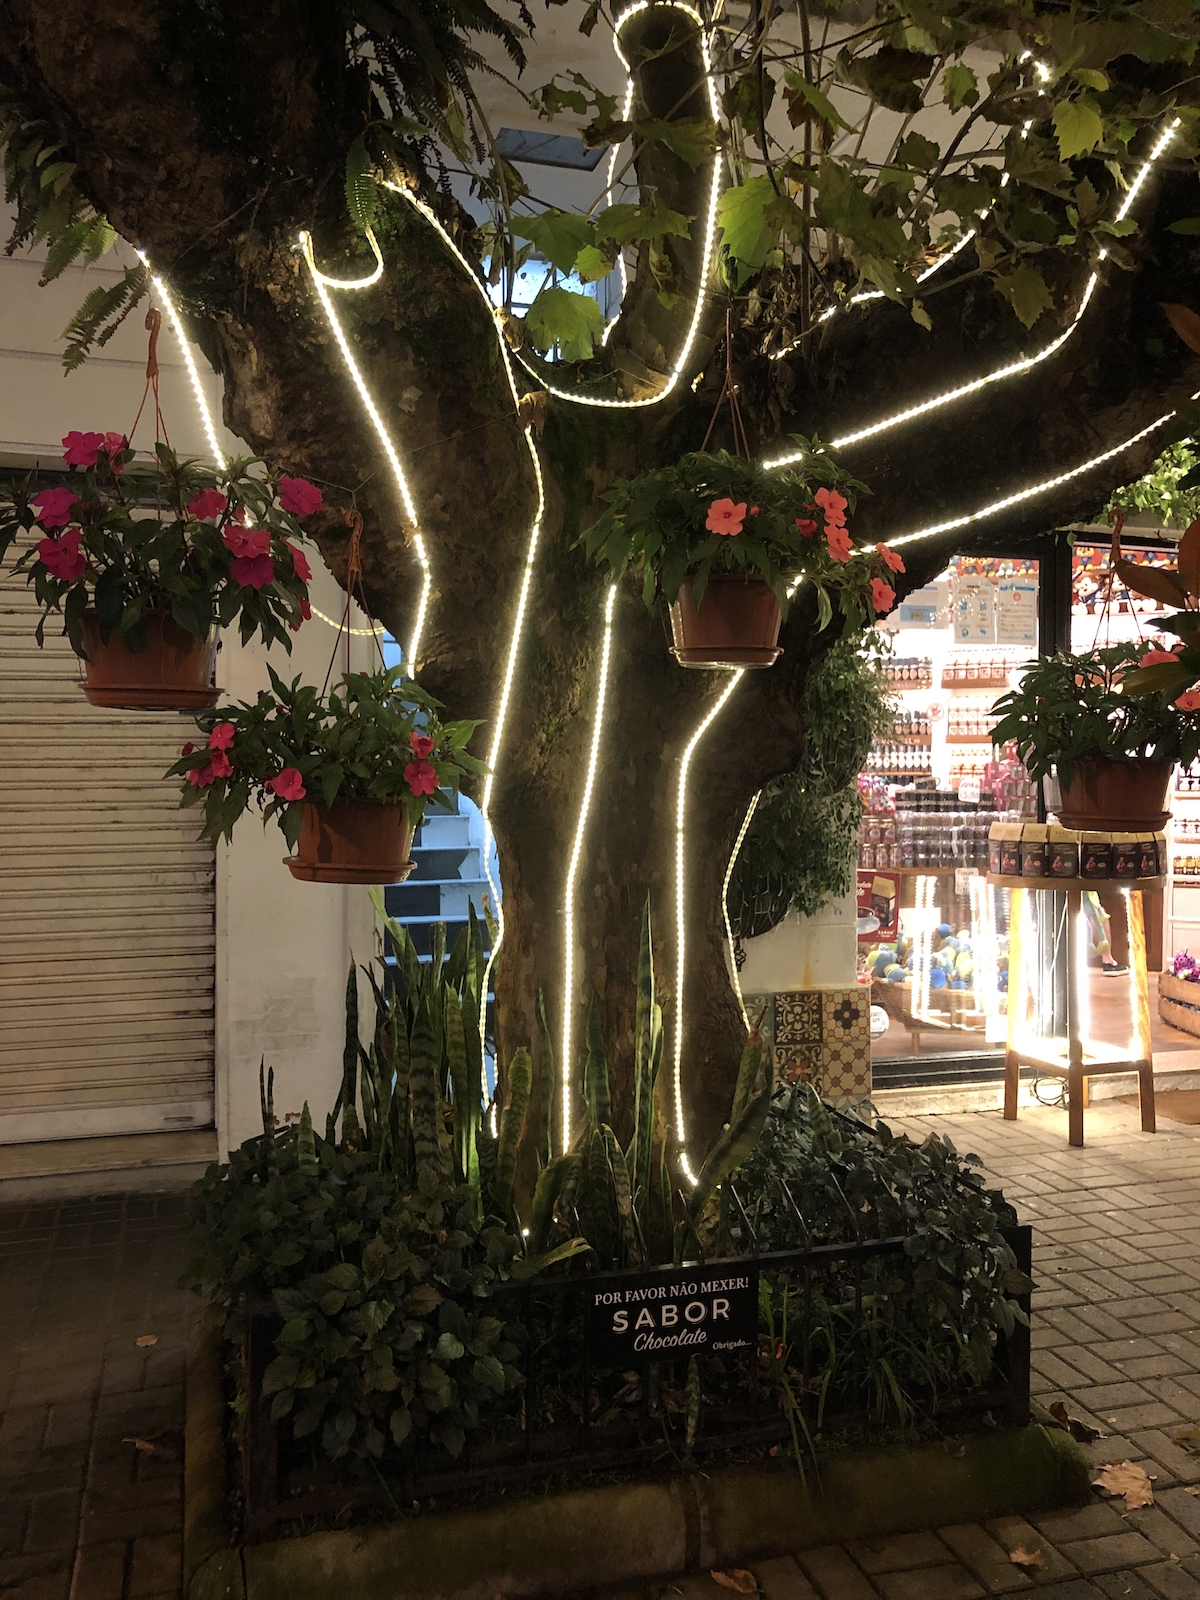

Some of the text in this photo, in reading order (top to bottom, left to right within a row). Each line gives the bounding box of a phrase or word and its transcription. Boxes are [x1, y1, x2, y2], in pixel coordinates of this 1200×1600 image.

[594, 1276, 749, 1306] POR FAVOR NÃO MEXER!
[612, 1298, 731, 1334] SABOR
[633, 1327, 708, 1352] Chocolate
